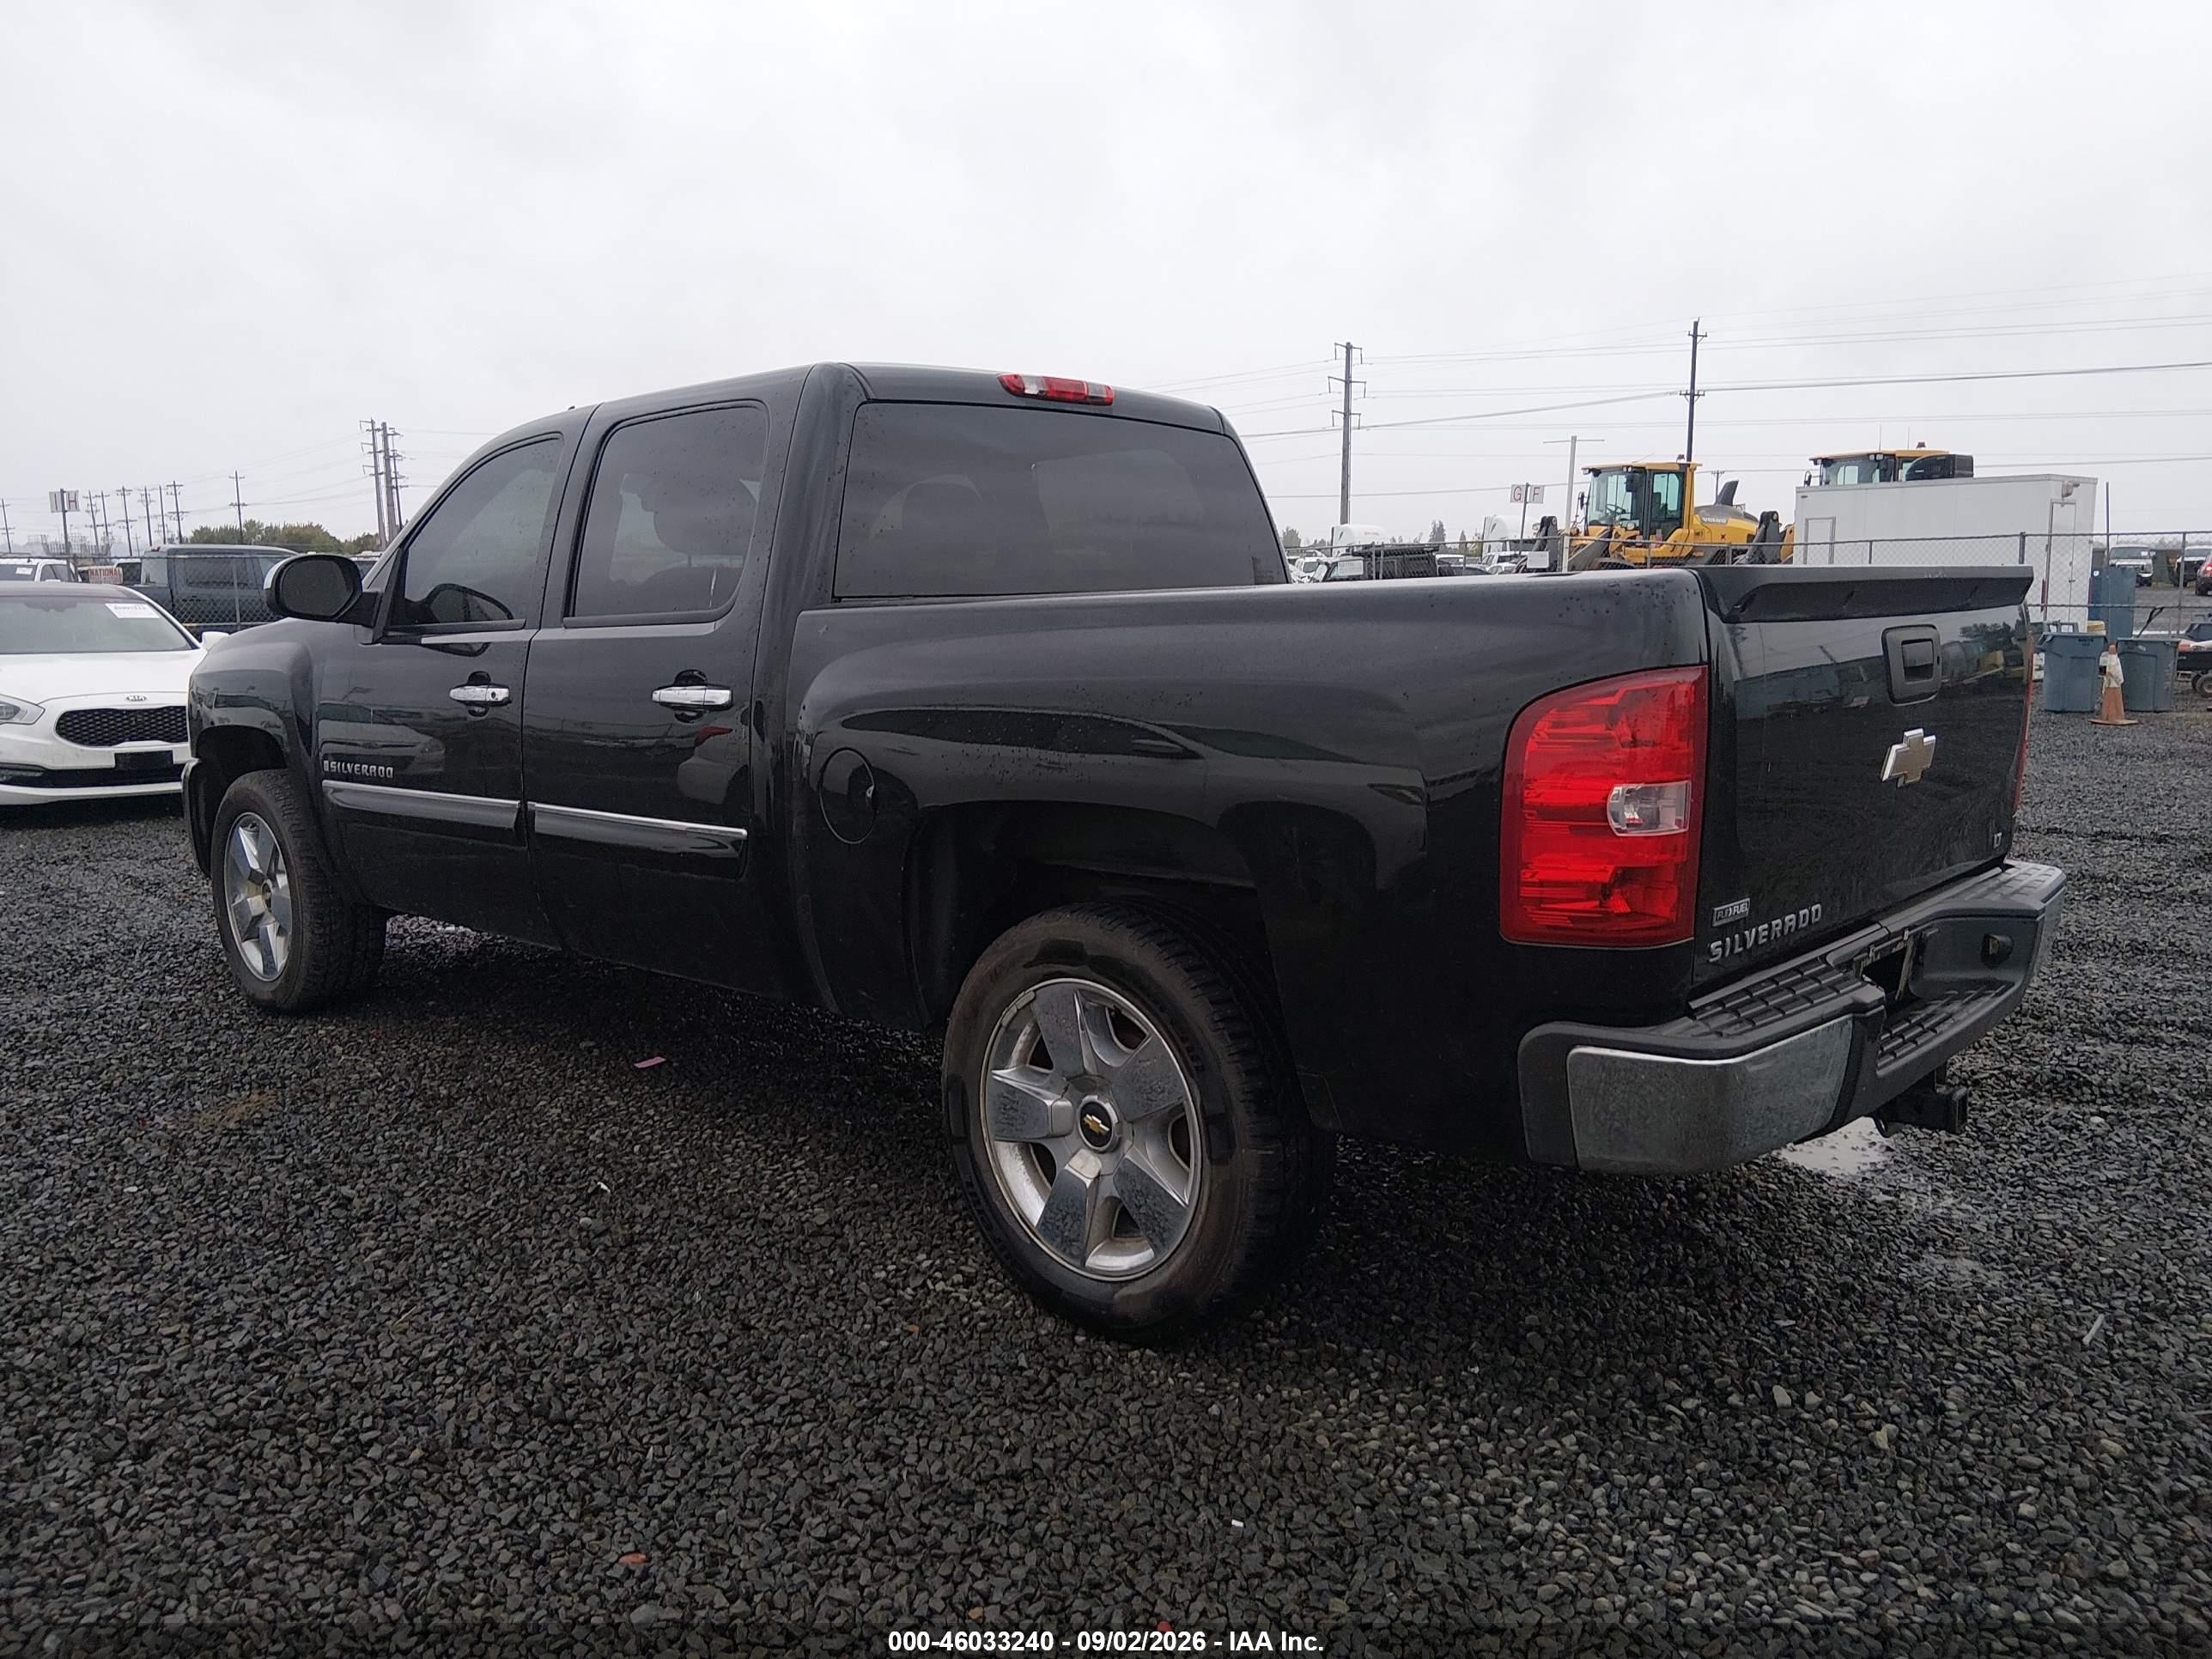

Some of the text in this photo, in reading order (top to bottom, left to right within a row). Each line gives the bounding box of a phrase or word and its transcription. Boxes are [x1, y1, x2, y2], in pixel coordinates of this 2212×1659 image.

[68, 492, 77, 511] H
[1513, 486, 1522, 501] G
[1533, 487, 1540, 502] F
[330, 761, 394, 779] SILVERADO
[1708, 903, 1821, 962] SILVERADO
